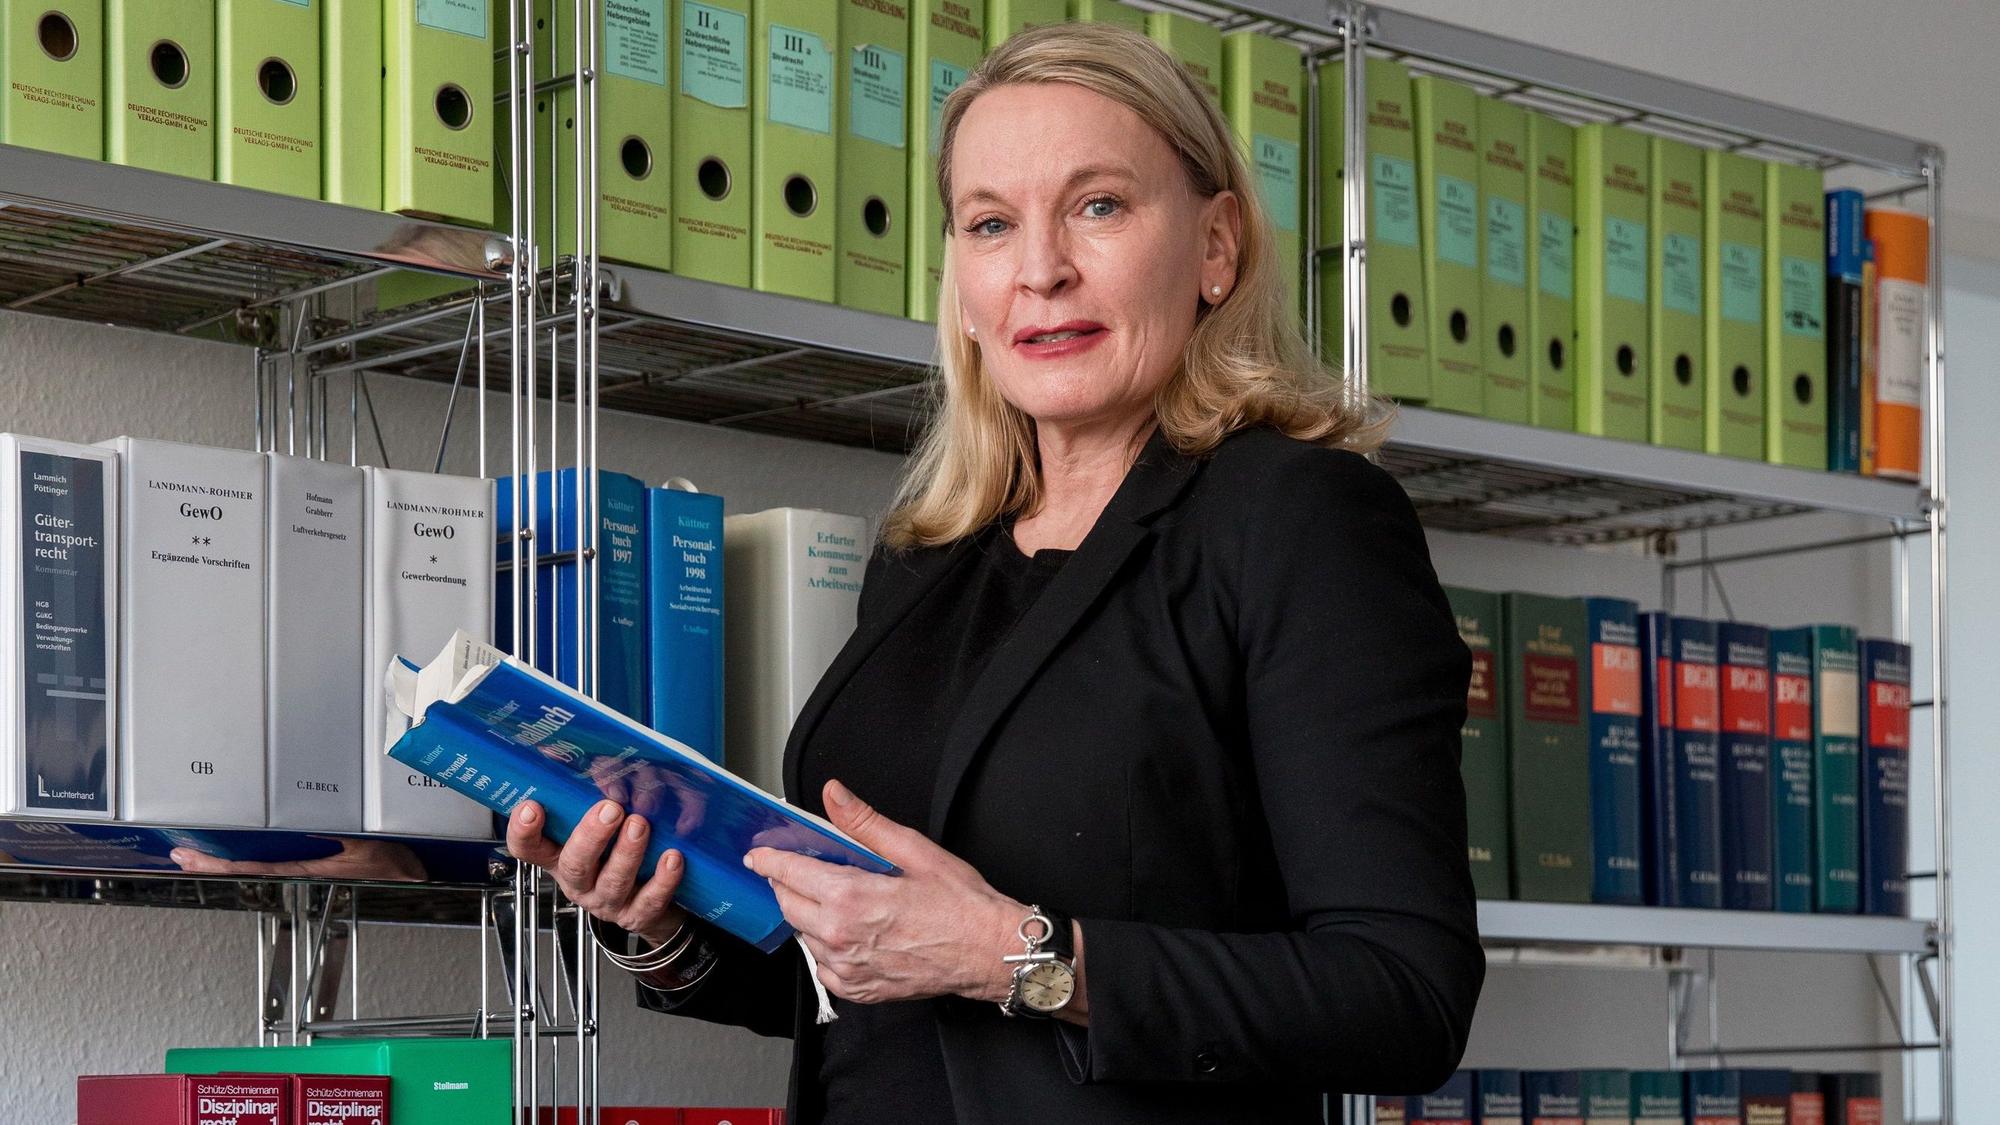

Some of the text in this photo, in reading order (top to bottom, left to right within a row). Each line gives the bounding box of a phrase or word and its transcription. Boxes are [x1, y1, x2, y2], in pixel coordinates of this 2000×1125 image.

[698, 10, 719, 31] II d
[785, 35, 803, 53] III
[864, 50, 880, 69] III
[12, 82, 96, 106] DEUTSCHE RECHTSPRECHUNG
[128, 103, 208, 127] DEUTSCHE RECHTSPRECHUNG
[233, 127, 314, 148] DEUTSCHE RECHTSPRECHUNG
[414, 146, 489, 168] DEUTSCHE RECHTSPRECHUNG
[33, 473, 67, 484] Lammich
[33, 484, 69, 497] Pöttinger
[149, 480, 253, 500] LANDMANN-ROHMER
[306, 492, 333, 505] Hofmann
[608, 498, 635, 513] Küttner
[180, 502, 223, 521] GewO
[305, 506, 333, 518] Grabherr
[387, 500, 485, 519] LANDMANN/ROHMER
[34, 513, 75, 530] Güter-
[603, 518, 639, 535] Personal-
[678, 515, 711, 529] Küttner
[292, 524, 347, 541] Luftverkehrsgesetz
[413, 521, 455, 540] GewO
[34, 530, 98, 548] transport-
[612, 533, 631, 548] buch
[672, 535, 716, 552] Personal-
[817, 532, 855, 546] Erfurter
[35, 546, 68, 561] recht
[151, 550, 251, 571] Ergänzende Vorschriften
[613, 548, 632, 564] 1997
[683, 551, 706, 564] buch
[808, 546, 863, 562] Kommentar
[35, 565, 79, 577] Kommentar
[401, 570, 467, 587] Gewerbeordnung
[685, 566, 706, 580] 1998
[828, 566, 848, 575] zum
[679, 584, 712, 594] Arbeitsrecht
[669, 602, 720, 616] Sozialversicherung
[35, 622, 88, 634] Bedingungswerke
[35, 634, 75, 645] Verwaltungs-
[35, 643, 72, 652] vorschriften
[420, 744, 445, 766] Küttner
[437, 753, 468, 780] Personal-
[456, 766, 478, 783] buch
[296, 780, 339, 793] C.H.BECK
[473, 774, 492, 791] 1999
[52, 789, 95, 800] Luchterhand
[198, 1085, 279, 1096] Schütz/Schmiemann
[307, 1088, 383, 1098] Schütz/Schmiemann
[200, 1099, 278, 1118] Disziplinar-
